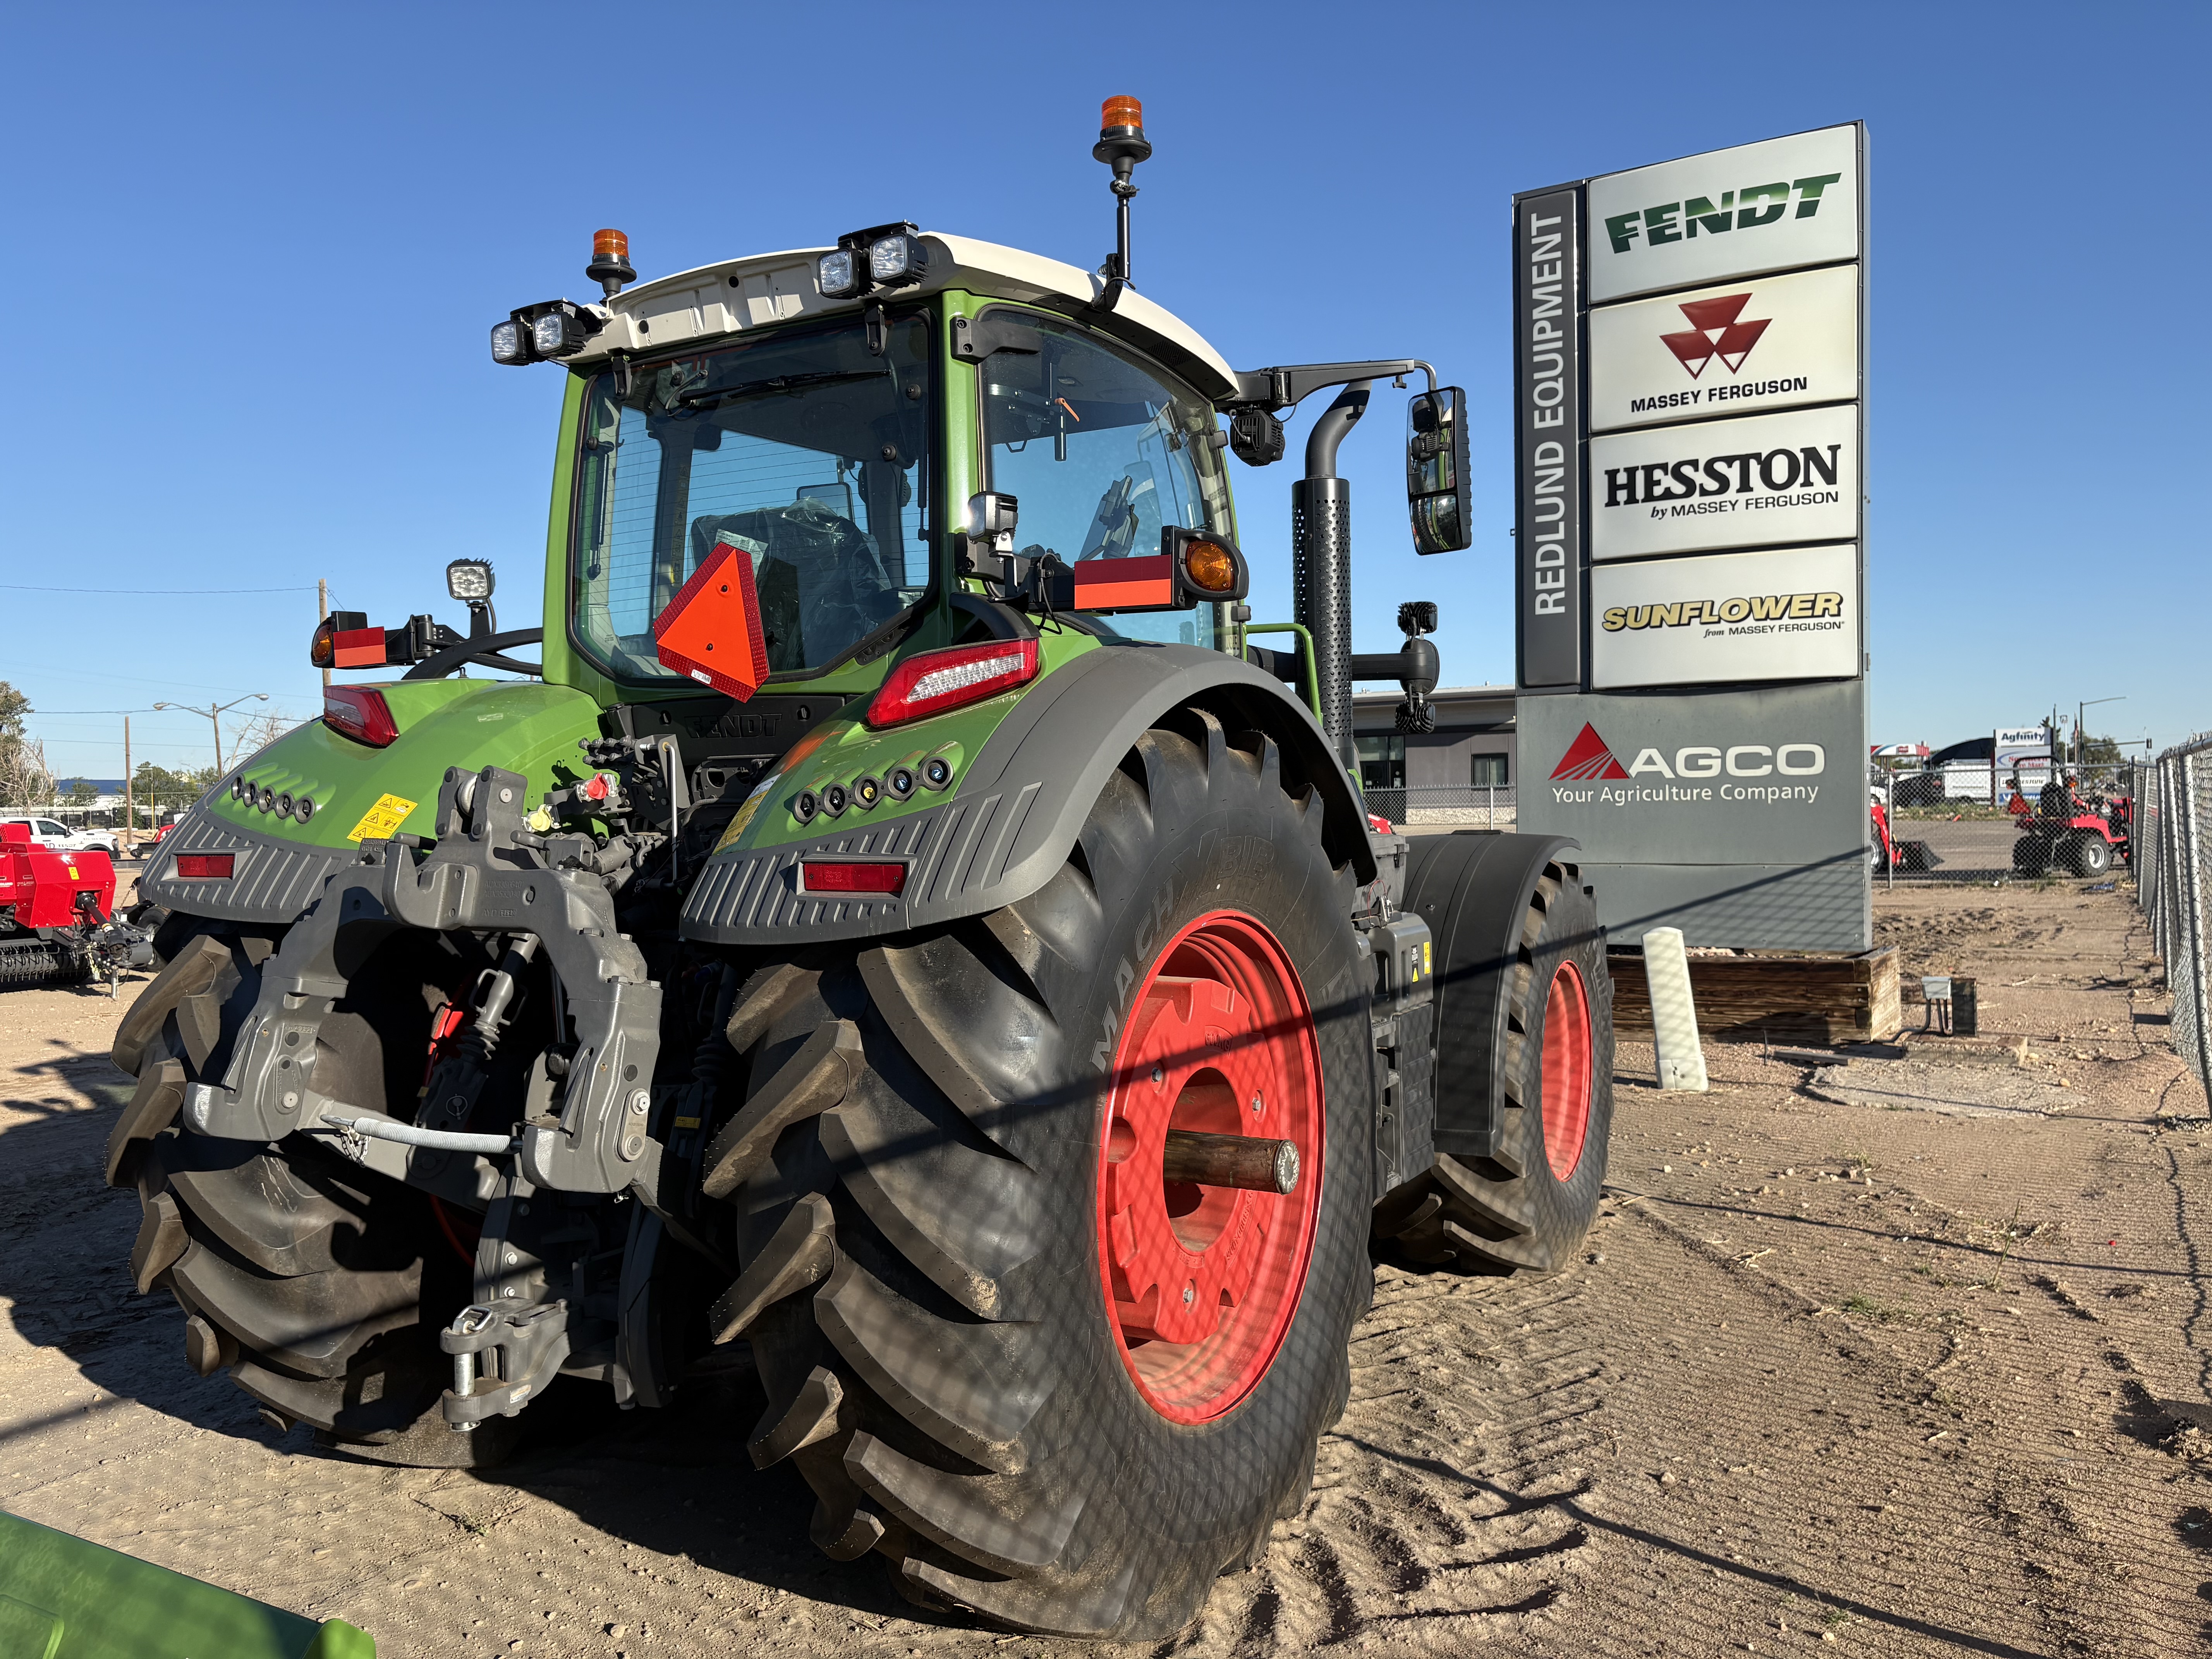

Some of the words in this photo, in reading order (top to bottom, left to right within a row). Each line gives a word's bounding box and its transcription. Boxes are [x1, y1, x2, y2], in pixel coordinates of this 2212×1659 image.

[1605, 172, 1841, 254] FENDT
[1531, 213, 1564, 429] EQUIPMENT
[1631, 390, 1701, 413] MASSEY
[1708, 376, 1807, 401] FERGUSON
[1605, 444, 1841, 507] HESSTON
[1650, 505, 1667, 520] by
[1671, 499, 1739, 517] MASSEY
[1745, 491, 1838, 510] FERGUSON
[1534, 441, 1565, 615] REDLUND
[1602, 591, 1844, 632] SUNFLOWER
[1703, 628, 1724, 638] from
[1729, 624, 1775, 636] MASSEY
[684, 714, 782, 738] FENDT
[2001, 731, 2045, 742] Agfinity
[1628, 743, 1825, 778] AGCO
[1552, 787, 1594, 803] Your
[1600, 784, 1711, 806] Agriculture
[1720, 784, 1819, 804] Company
